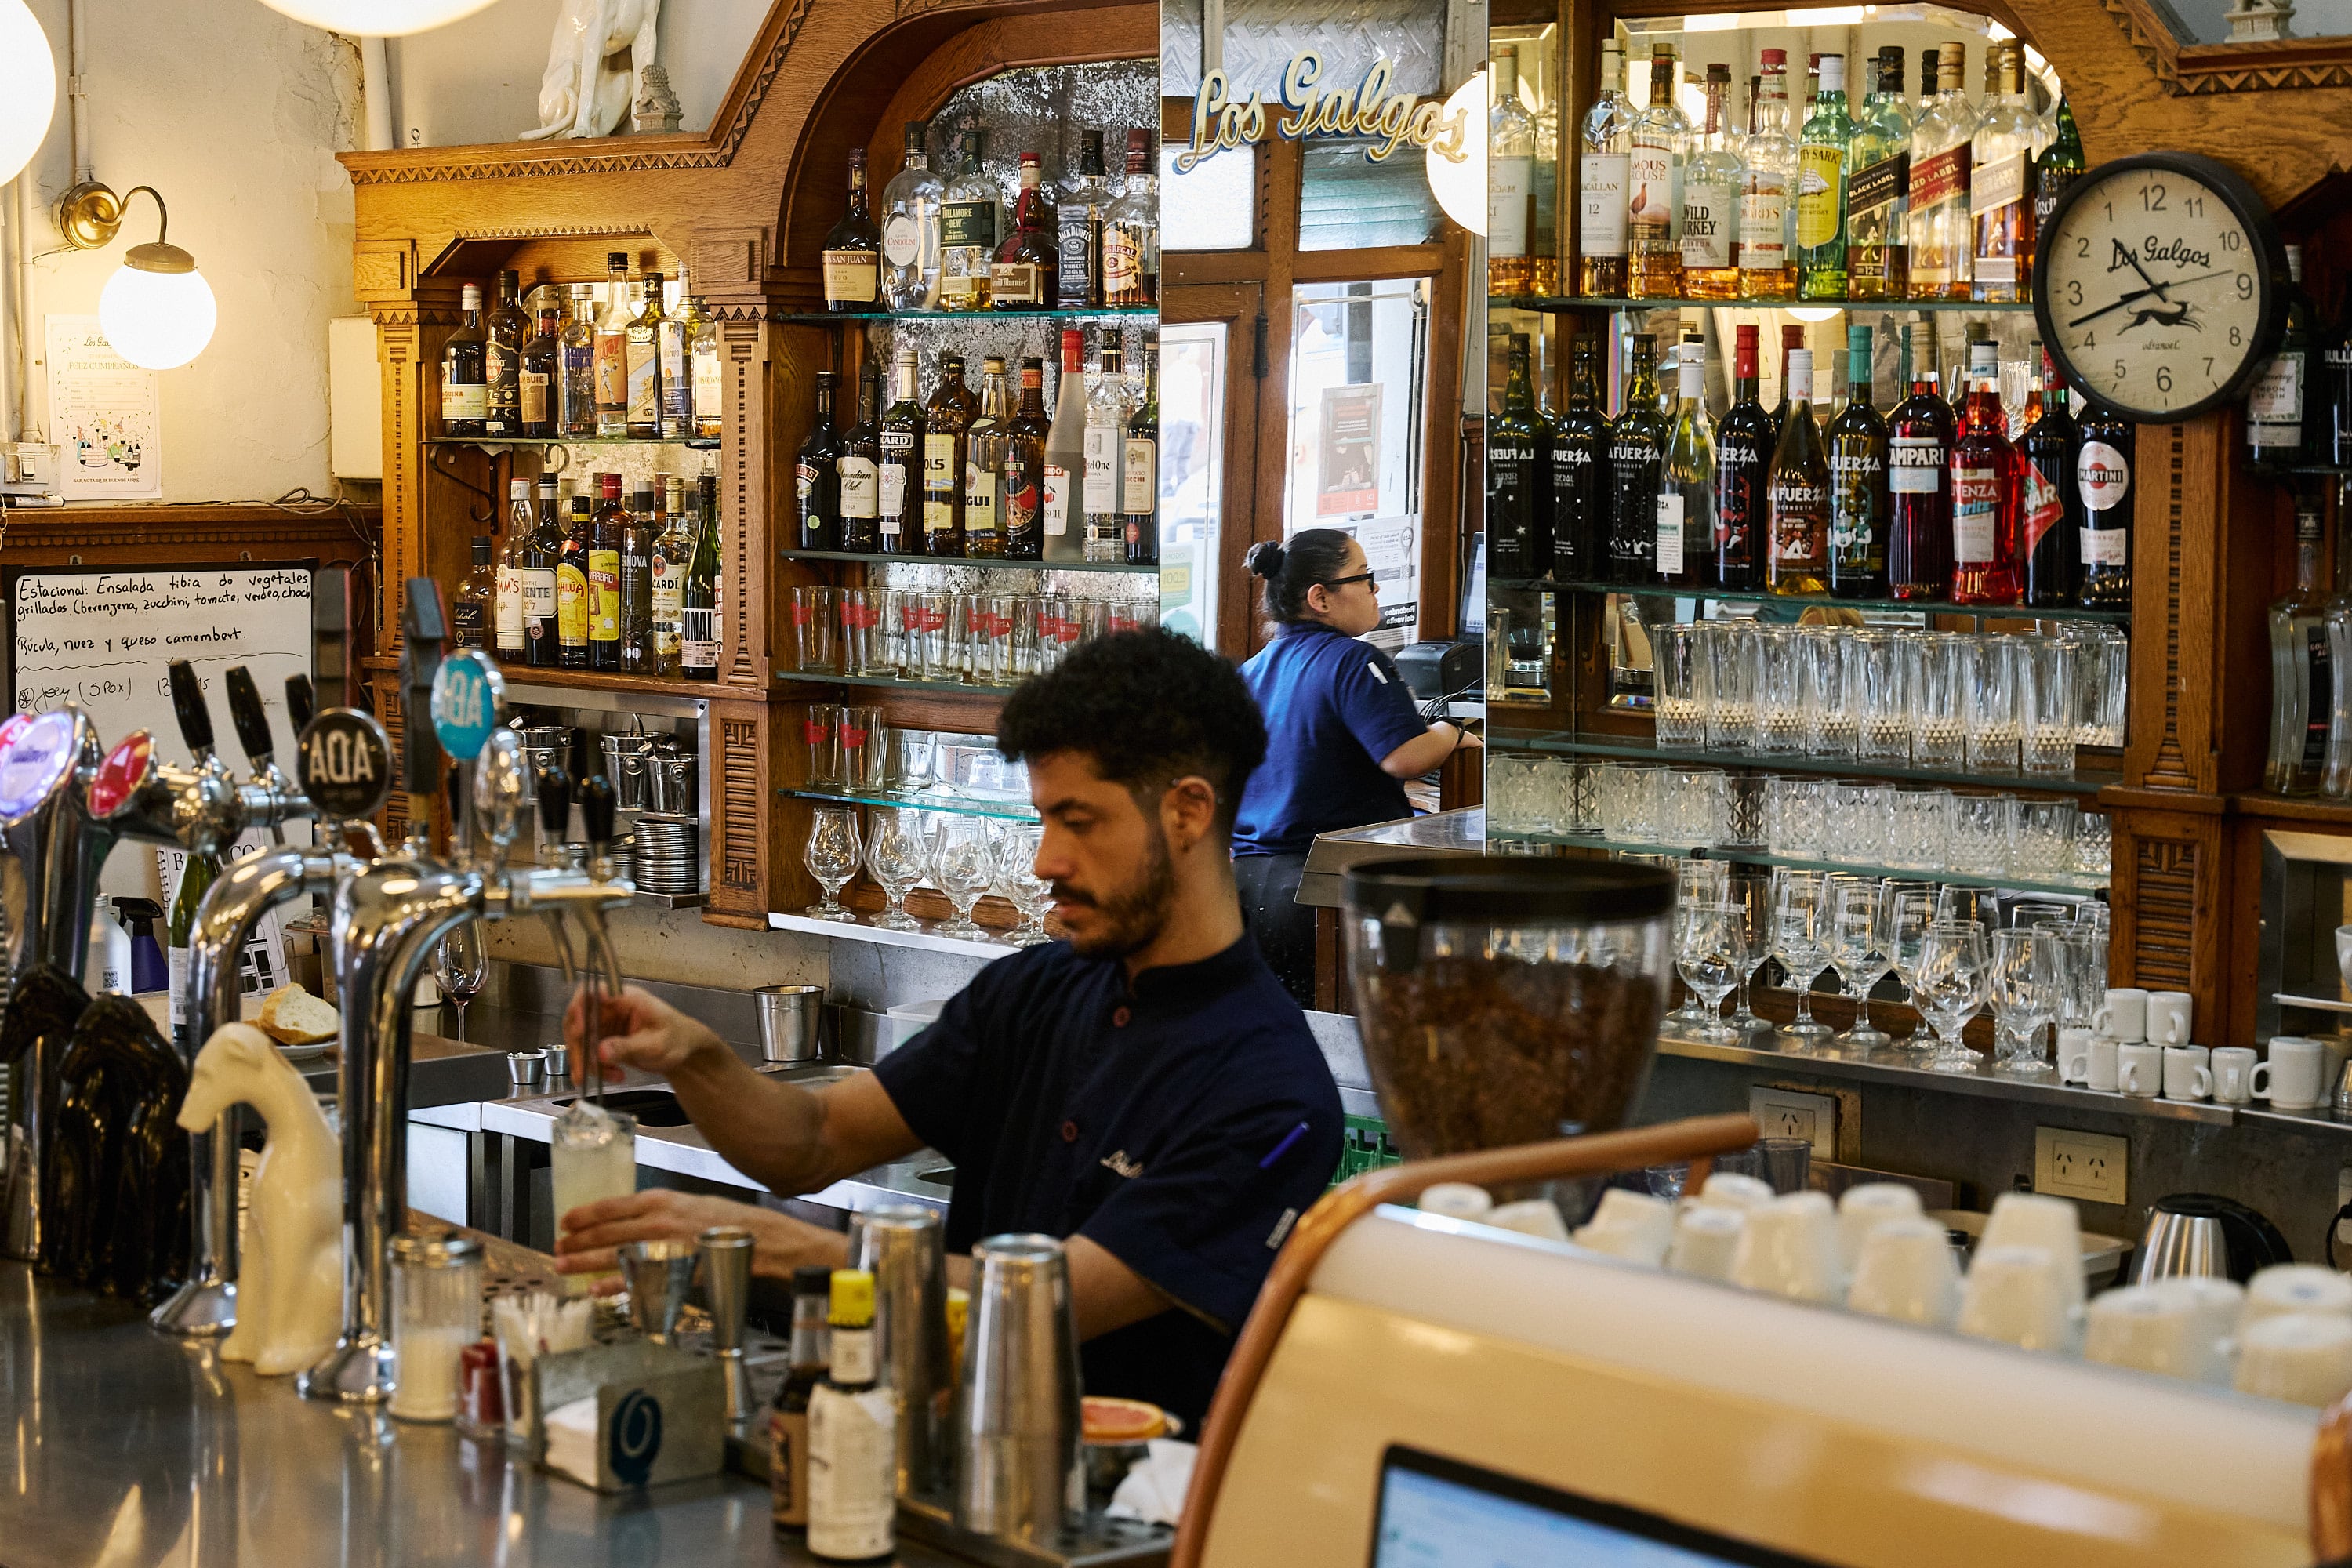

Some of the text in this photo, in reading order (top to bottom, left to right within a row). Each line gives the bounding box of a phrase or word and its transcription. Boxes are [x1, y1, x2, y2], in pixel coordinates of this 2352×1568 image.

[1171, 49, 1468, 175] Los Galgos
[1812, 149, 1839, 164] SARK
[1849, 173, 1896, 198] BLACK LABEL
[1908, 177, 1926, 191] RED
[1927, 163, 1958, 182] LABEL
[2138, 184, 2166, 212] 12
[2184, 197, 2204, 219] 11
[942, 206, 973, 219] TULLAMORE
[1588, 203, 1600, 215] 12
[2104, 201, 2113, 222] 1
[949, 219, 962, 228] DEW
[1070, 225, 1093, 242] DANIEL'S
[887, 238, 916, 246] CANDOLINI
[1112, 245, 1136, 257] REGAL
[2077, 238, 2090, 258] 2
[2218, 230, 2241, 251] 10
[2143, 235, 2211, 268] Galgos
[2067, 280, 2084, 306] 3
[2236, 273, 2253, 300] 9
[83, 336, 96, 347] Los
[2083, 331, 2096, 350] 4
[2229, 326, 2242, 347] 8
[2114, 359, 2126, 379] 5
[2202, 357, 2215, 377] 7
[2156, 366, 2172, 392] 6
[1094, 459, 1110, 470] One
[1614, 444, 1661, 466] FUERZA
[2079, 470, 2123, 482] MARTINI
[1777, 484, 1828, 507] FUERZA
[19, 579, 89, 601] Estacional:
[96, 576, 155, 595] Ensalada
[169, 573, 201, 590] tibia
[248, 571, 309, 590] vegetales
[194, 590, 240, 606] tomate,
[64, 639, 95, 651] nuez
[104, 638, 112, 653] y
[121, 636, 158, 651] queso
[165, 626, 246, 644] camembert.
[308, 729, 376, 784] AQA
